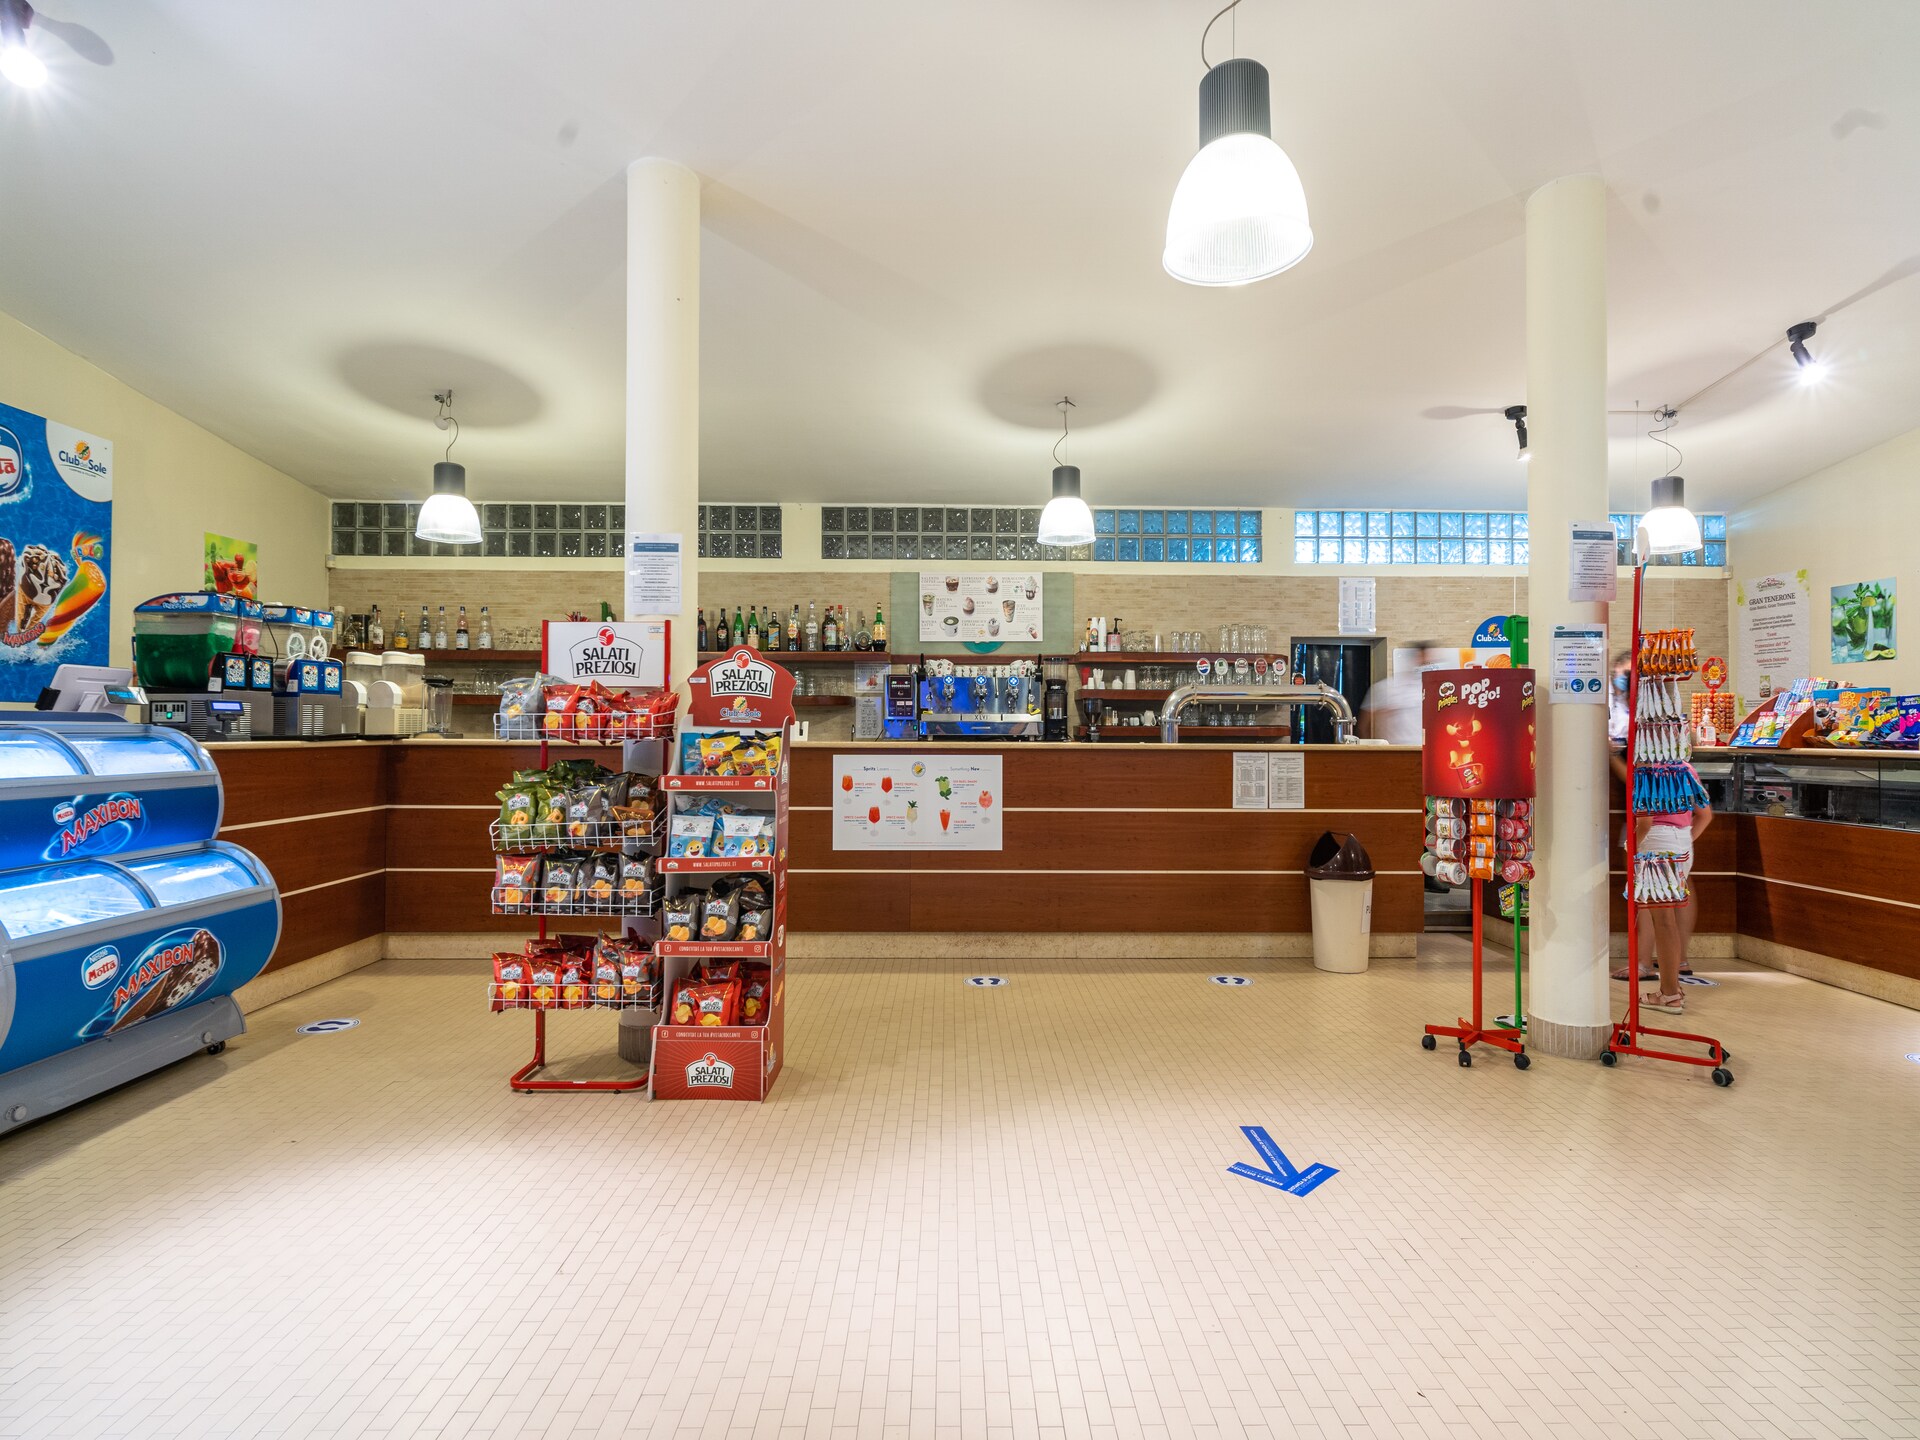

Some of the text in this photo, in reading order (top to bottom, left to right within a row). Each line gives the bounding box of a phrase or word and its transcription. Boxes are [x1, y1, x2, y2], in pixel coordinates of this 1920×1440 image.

[58, 450, 80, 466] Club
[89, 459, 107, 474] Sole
[1749, 592, 1796, 606] GRAN TENERONE
[1476, 634, 1492, 642] Club
[1498, 634, 1509, 642] So
[583, 647, 629, 661] SALATI
[576, 661, 636, 675] PREZIOSI
[722, 669, 762, 681] SALATI
[716, 680, 768, 693] PREZIOSI
[1468, 694, 1477, 705] &
[720, 708, 761, 718] Club Sole
[61, 798, 141, 856] MAXIBON
[87, 959, 117, 982] Motta
[112, 942, 194, 1013] MAXIBON
[695, 1066, 725, 1075] SALATI
[691, 1075, 729, 1085] PREZIOSI
